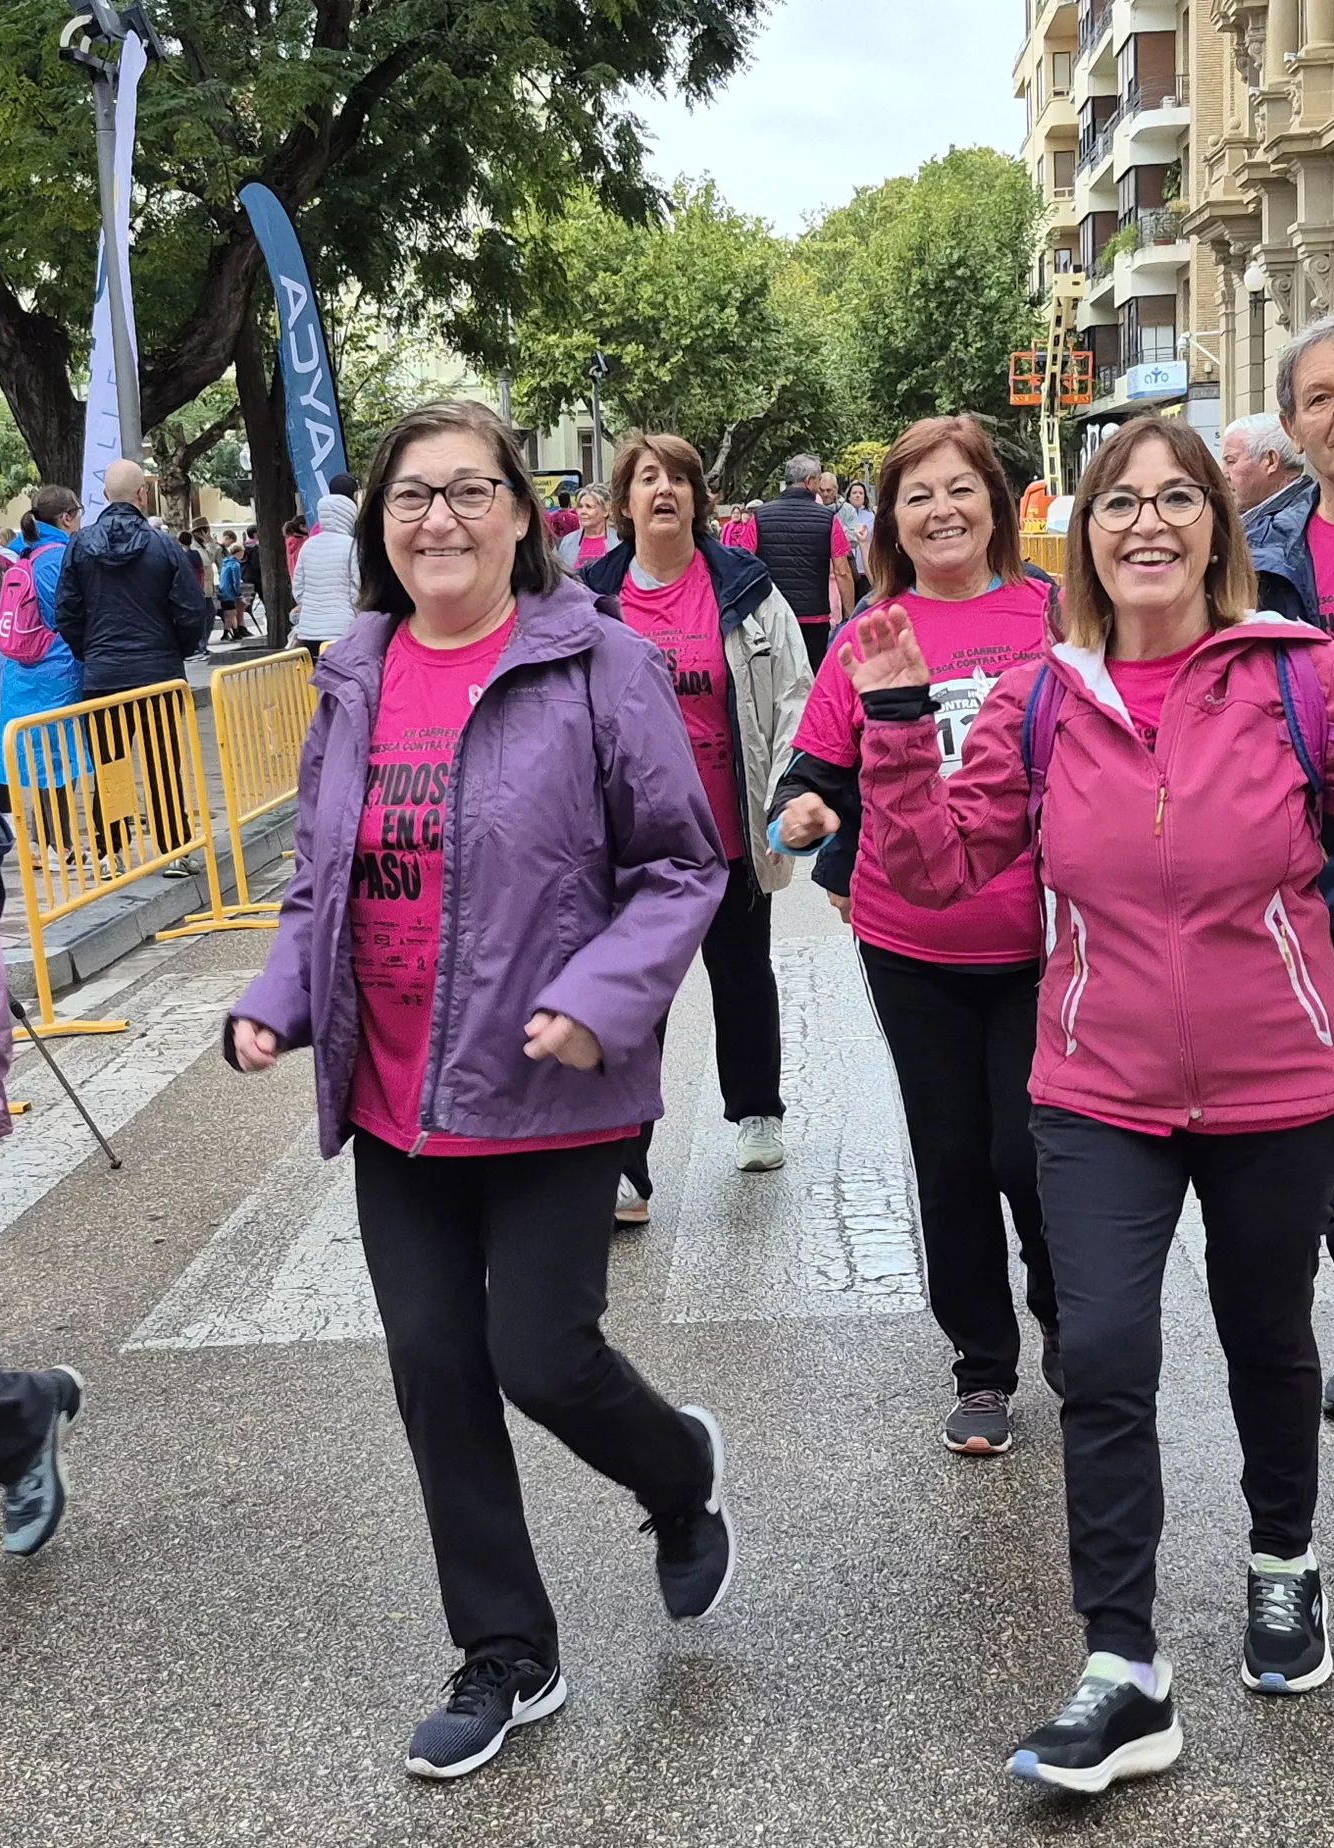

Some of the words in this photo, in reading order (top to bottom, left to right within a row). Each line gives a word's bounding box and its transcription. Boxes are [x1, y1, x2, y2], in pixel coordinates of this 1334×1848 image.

[930, 663, 955, 676] ESCA
[956, 656, 996, 667] CONTRA
[966, 646, 1012, 657] CARRERA
[937, 713, 977, 756] 1
[381, 809, 417, 850] EN
